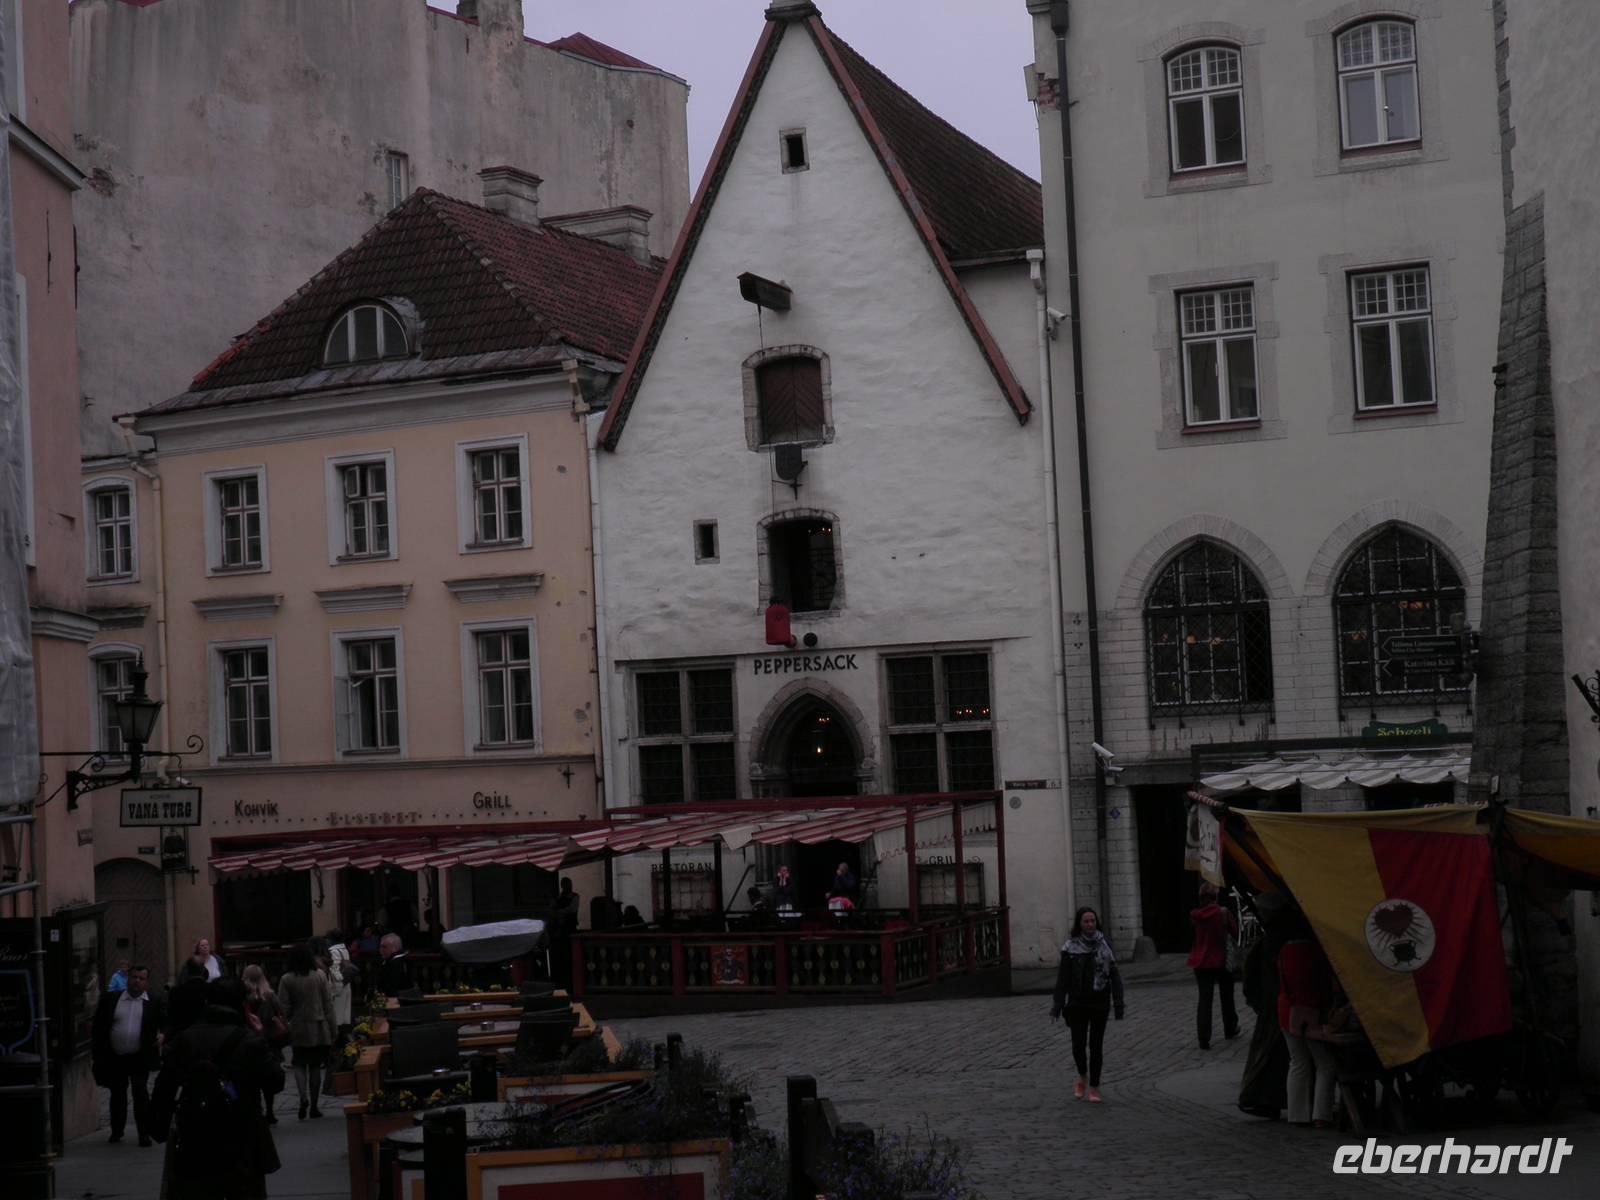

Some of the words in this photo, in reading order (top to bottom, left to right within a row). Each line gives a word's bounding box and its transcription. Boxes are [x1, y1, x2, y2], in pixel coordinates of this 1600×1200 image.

[753, 654, 858, 675] PEPPERSACK
[128, 803, 159, 819] VANA
[163, 802, 192, 818] TURG
